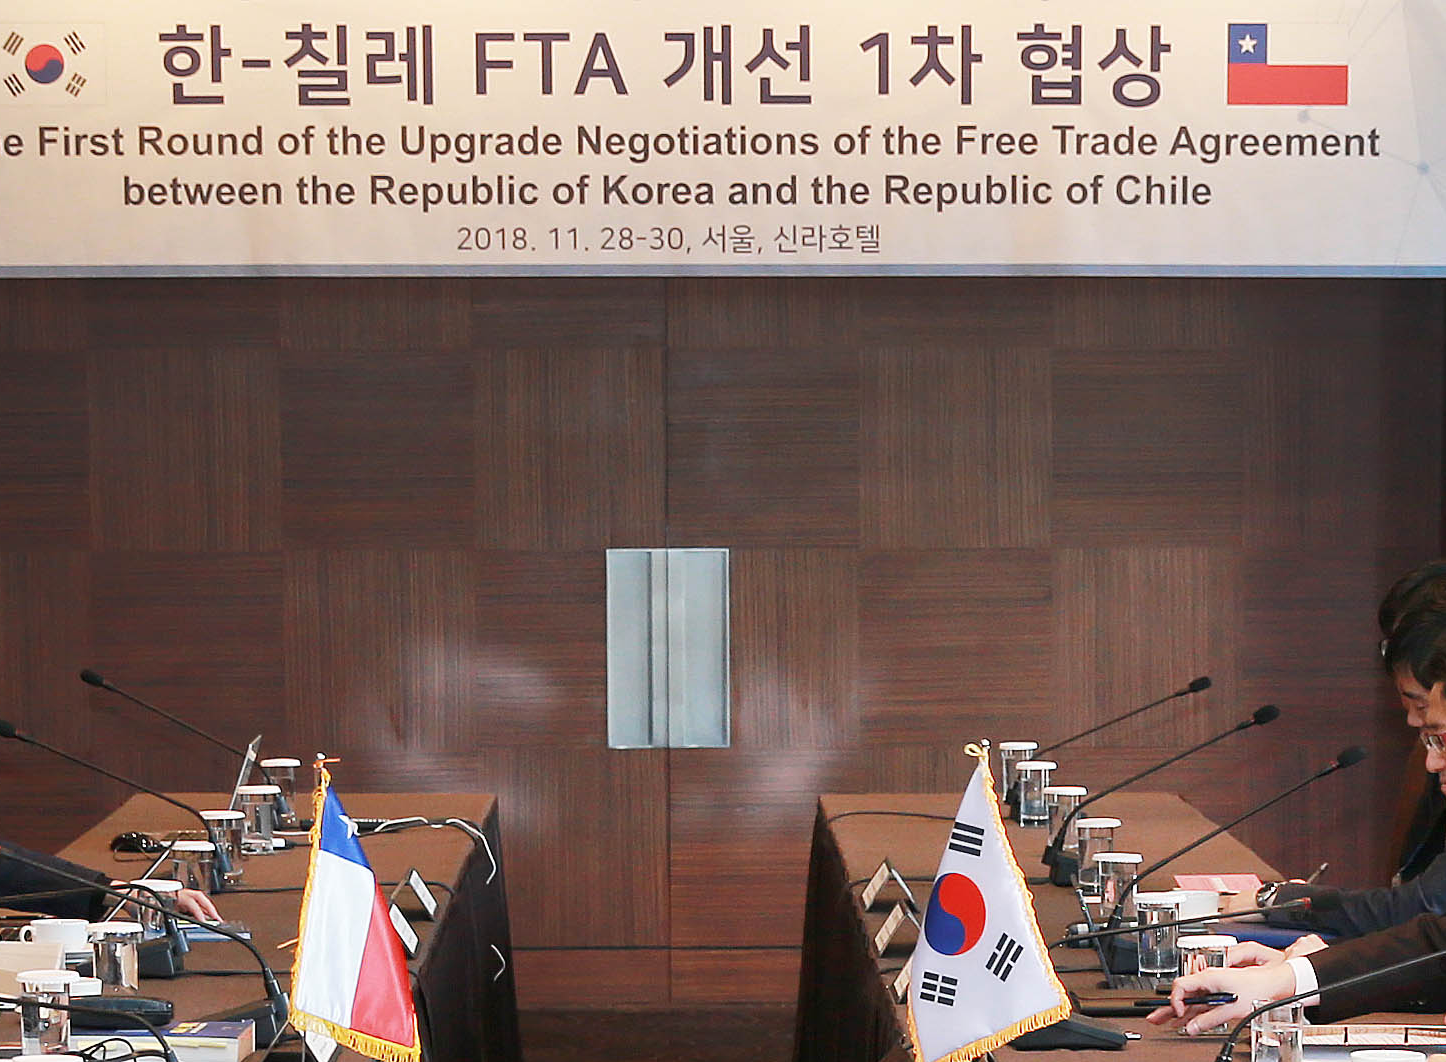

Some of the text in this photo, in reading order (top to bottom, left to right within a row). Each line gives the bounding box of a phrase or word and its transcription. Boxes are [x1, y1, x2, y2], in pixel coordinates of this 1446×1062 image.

[158, 23, 1172, 108] 한-칠레 FTA 개선 1차 협상
[38, 126, 125, 156] First
[138, 125, 263, 156] Round
[277, 125, 316, 156] of
[326, 125, 386, 156] the
[401, 125, 562, 164] Upgrade
[577, 125, 819, 164] Negotiations
[833, 125, 872, 156] of
[882, 125, 942, 155] the
[956, 125, 1038, 156] Free
[1051, 125, 1158, 156] Trade
[1169, 126, 1380, 164] Agreement
[123, 174, 1212, 213] between the Republic of Korea and the Republic of Chile
[457, 224, 880, 255] 2018. 11. 28-30, 서울, 신라호텔
